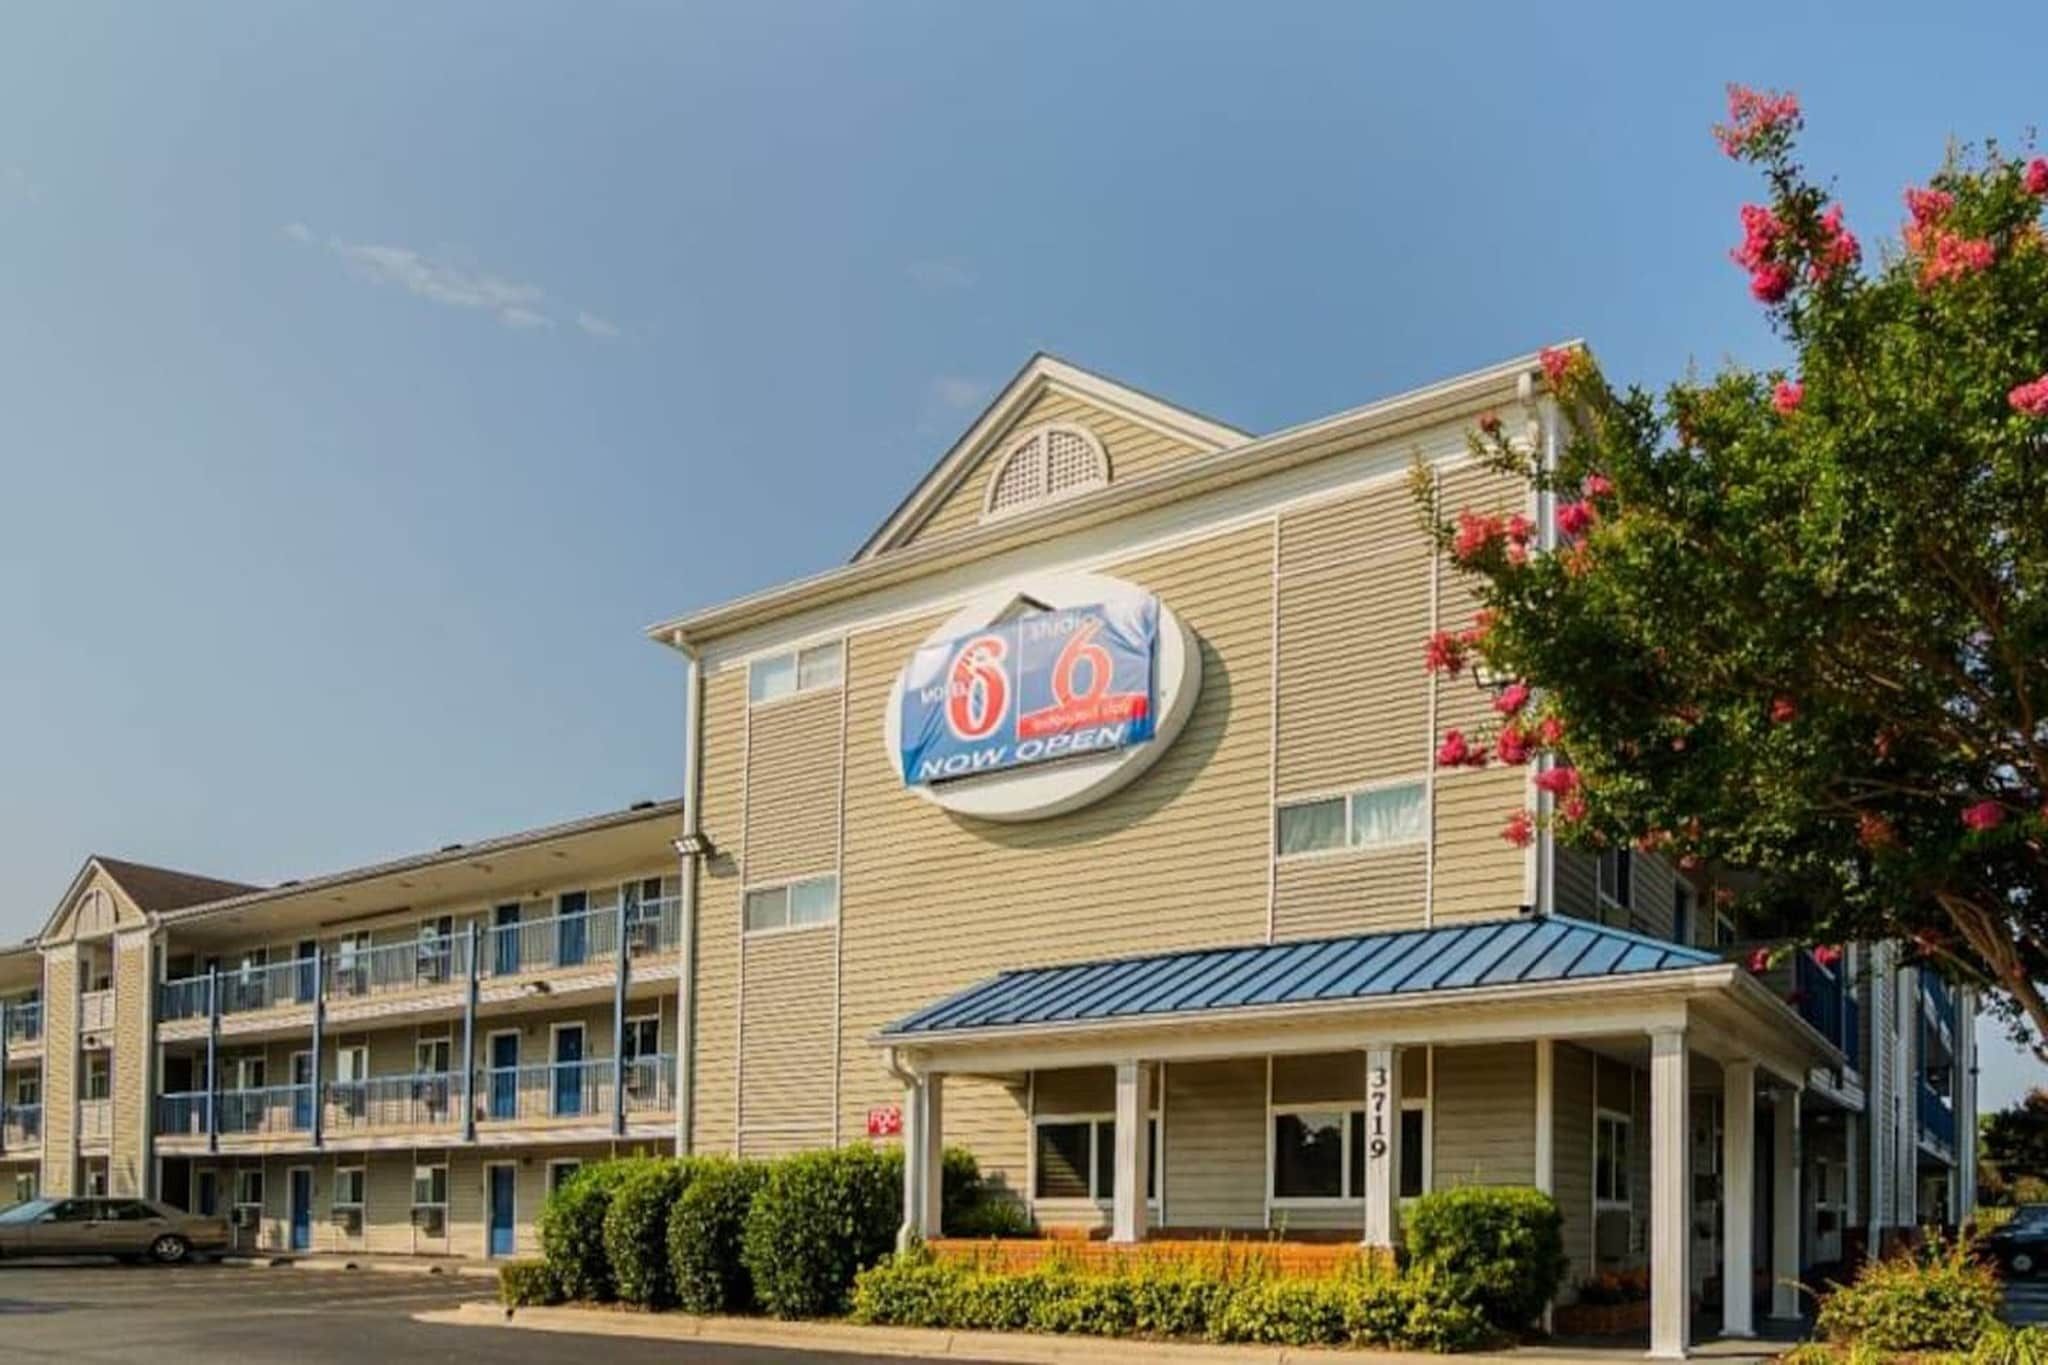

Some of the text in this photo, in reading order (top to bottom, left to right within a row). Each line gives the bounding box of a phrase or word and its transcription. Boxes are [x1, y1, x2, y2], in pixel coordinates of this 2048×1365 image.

[945, 635, 1010, 741] 6
[1051, 617, 1112, 707] 6
[919, 722, 1126, 779] NOW OPEN
[1370, 1067, 1387, 1160] 3719
